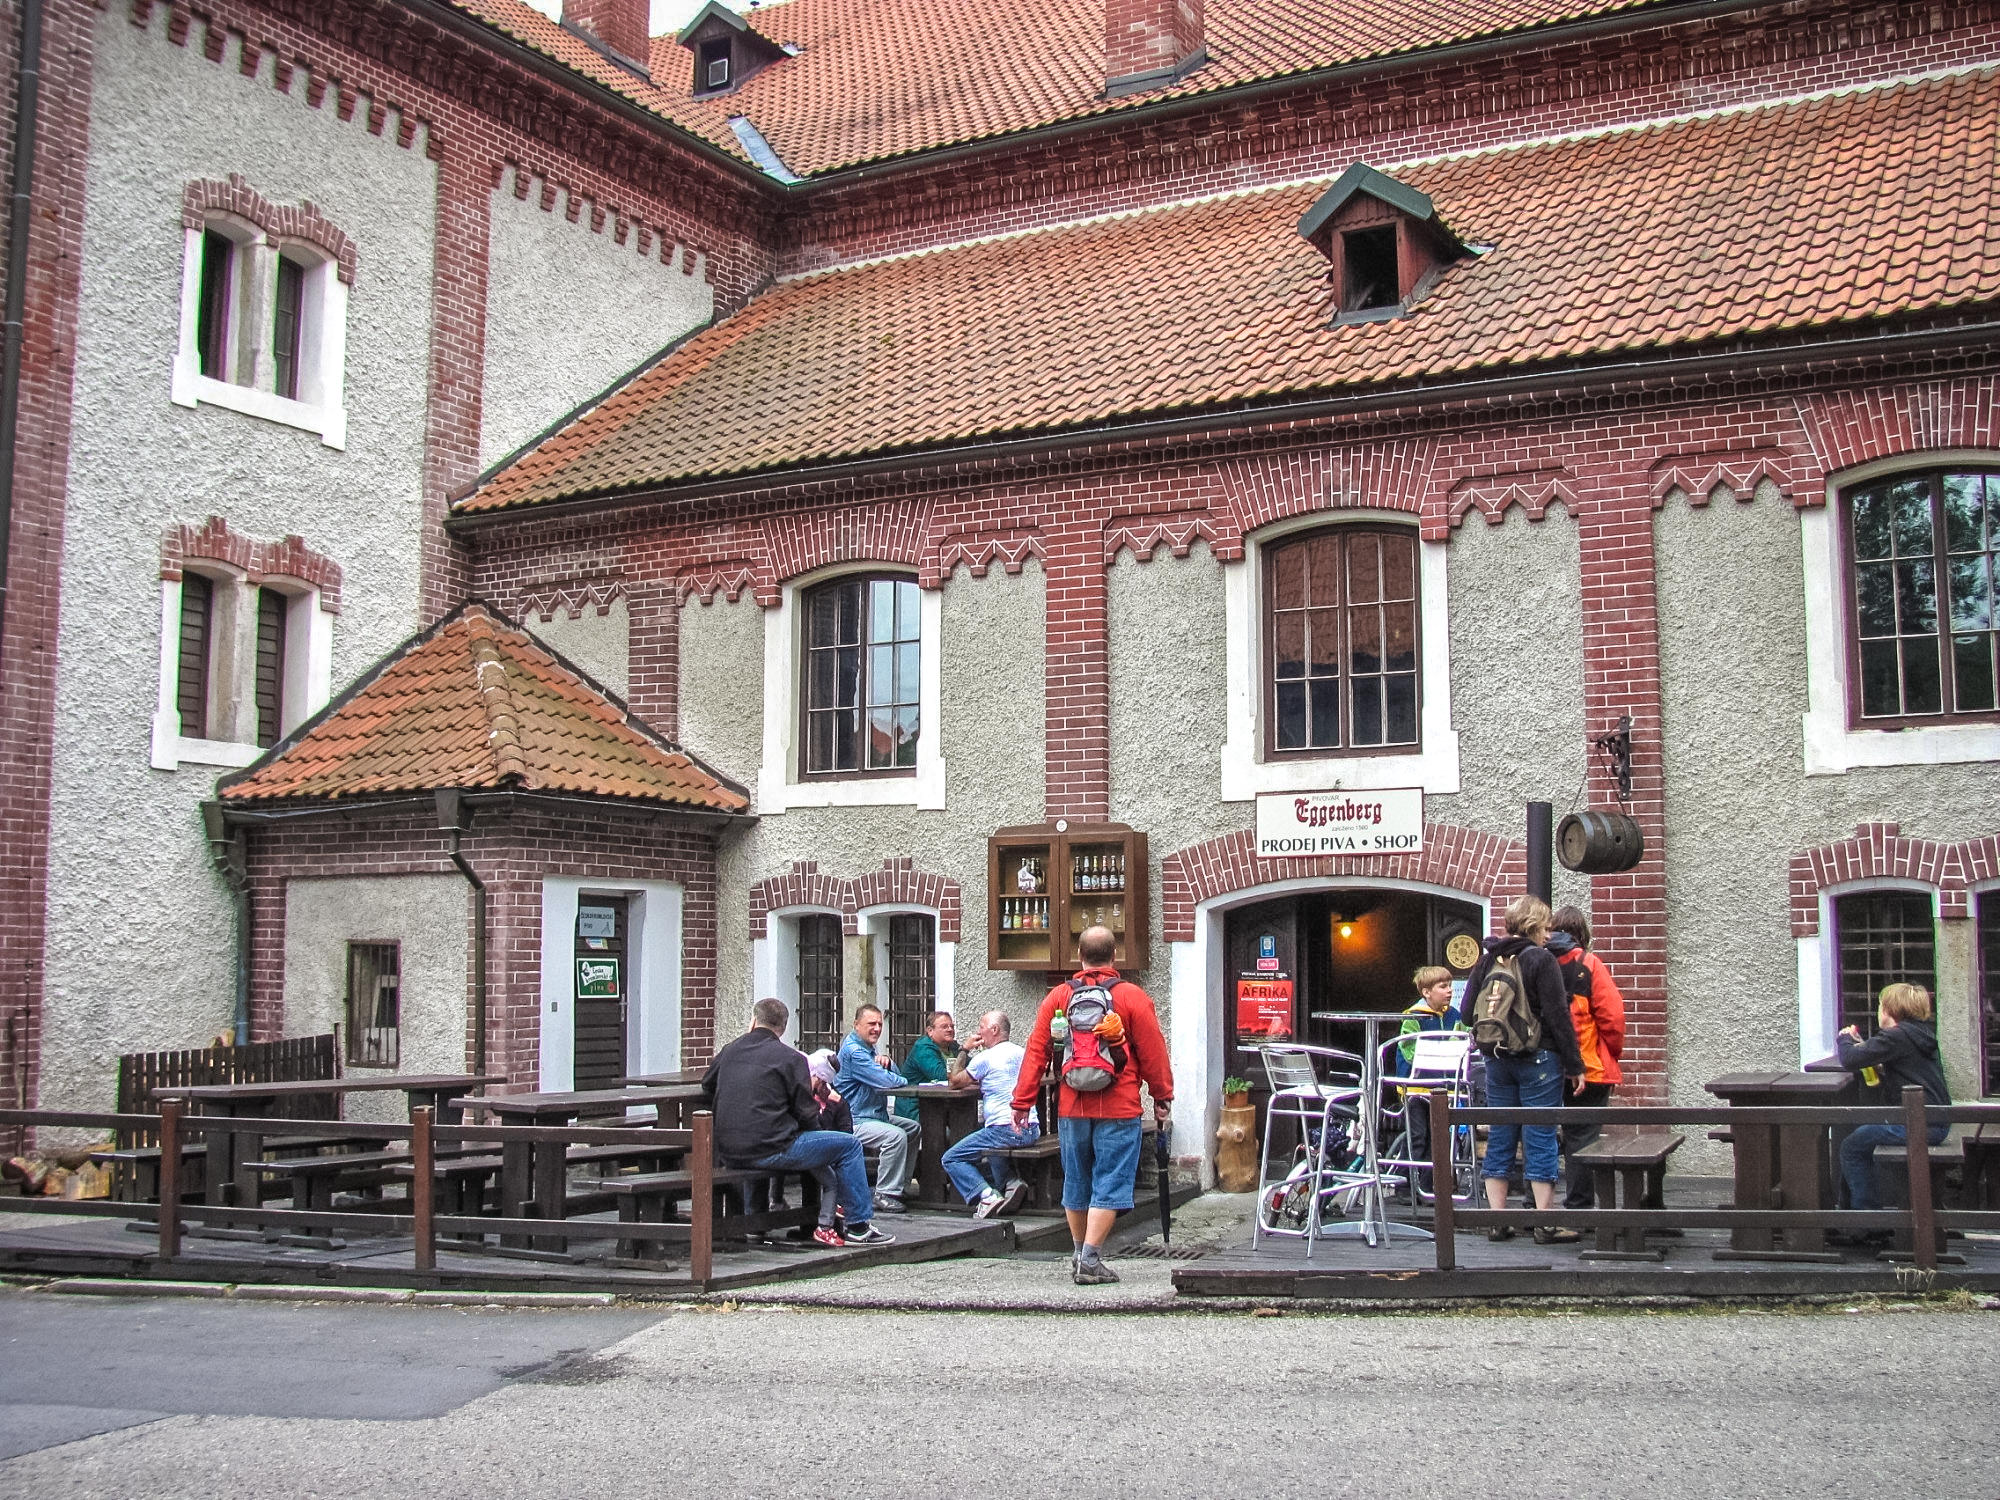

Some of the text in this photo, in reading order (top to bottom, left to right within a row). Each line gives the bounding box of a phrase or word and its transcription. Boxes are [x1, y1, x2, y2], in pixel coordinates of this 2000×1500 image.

[1295, 798, 1382, 827] Eggenberg
[1262, 834, 1418, 853] PRODEJ PIVA SHOP
[1241, 986, 1288, 997] AFRIKA
